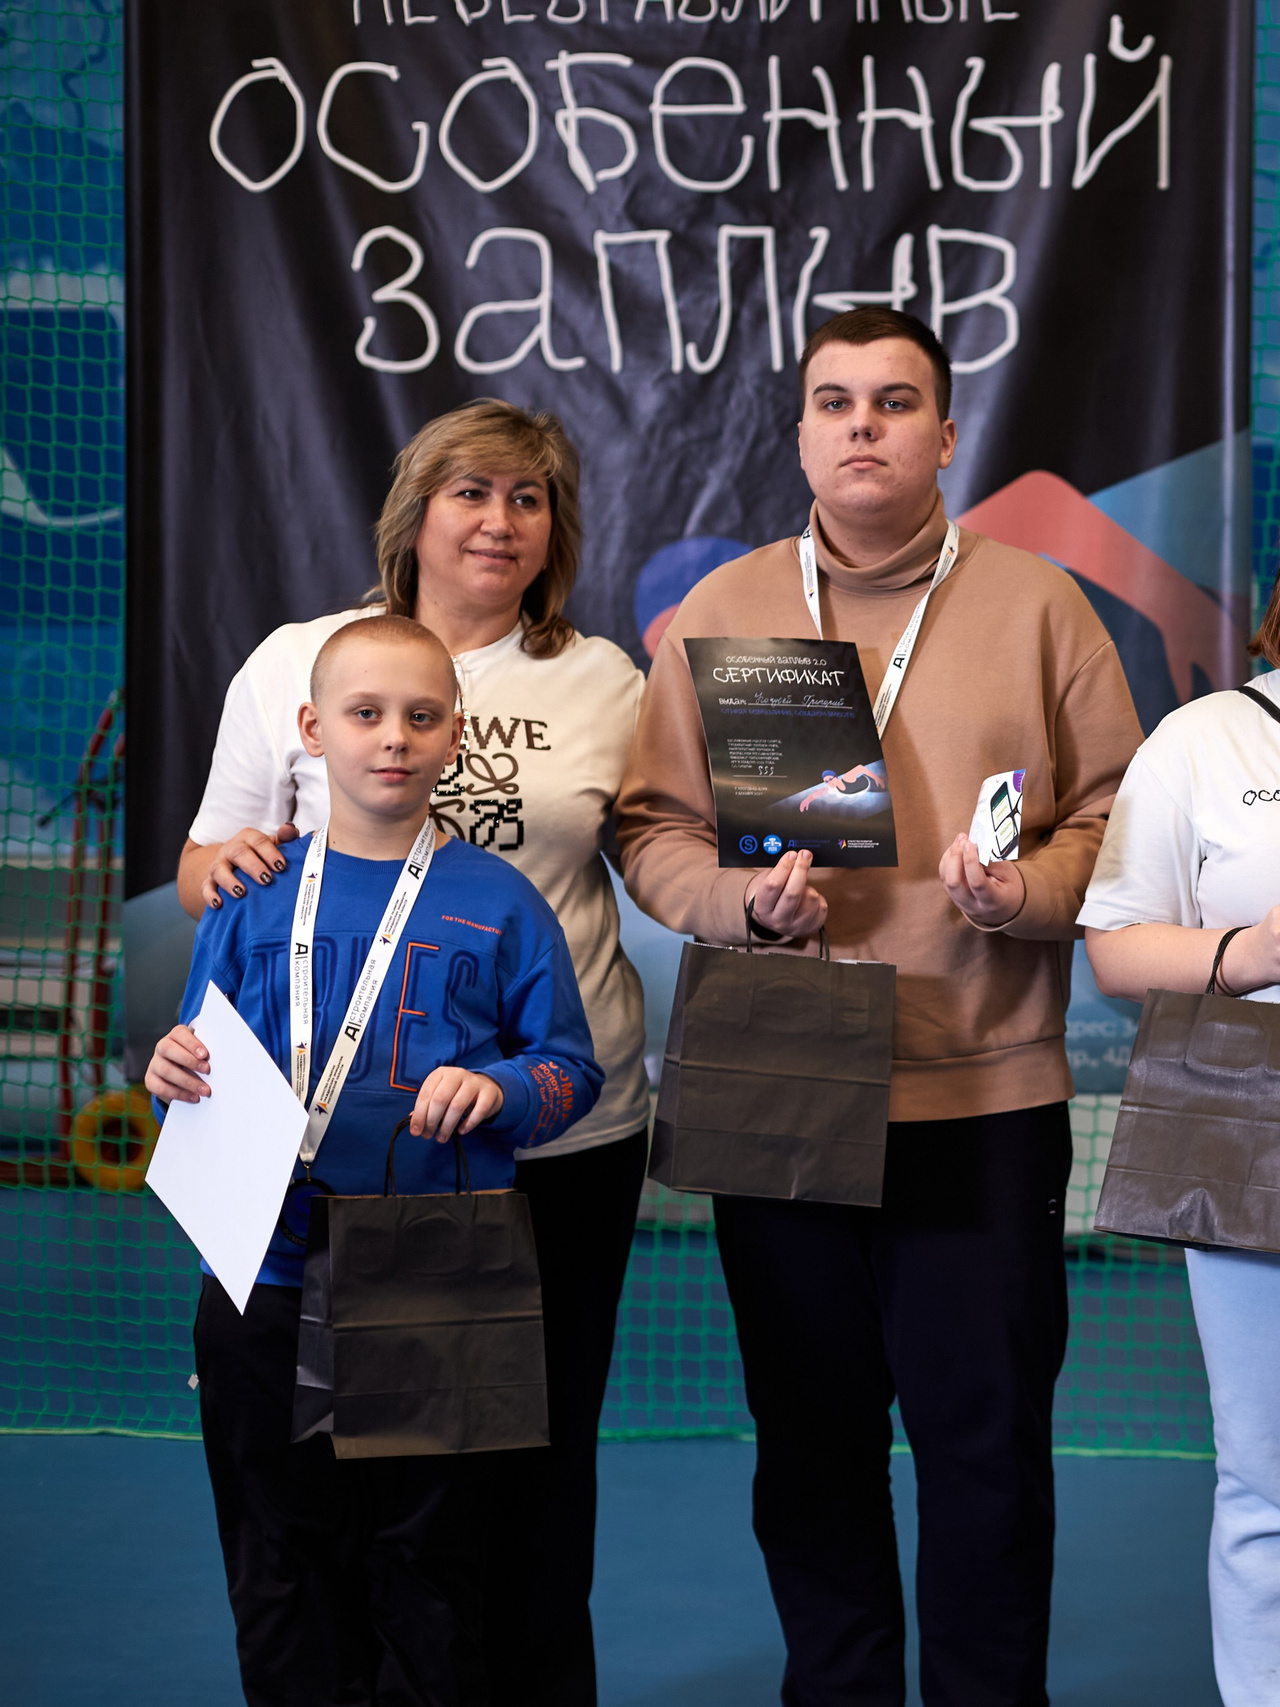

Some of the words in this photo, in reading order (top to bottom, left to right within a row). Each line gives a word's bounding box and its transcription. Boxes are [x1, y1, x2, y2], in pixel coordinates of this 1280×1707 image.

[713, 667, 845, 687] СЕРТИФИКАТ
[442, 914, 454, 922] FOR
[454, 916, 466, 924] THE
[350, 958, 376, 1021] строительная
[358, 980, 378, 1024] компания
